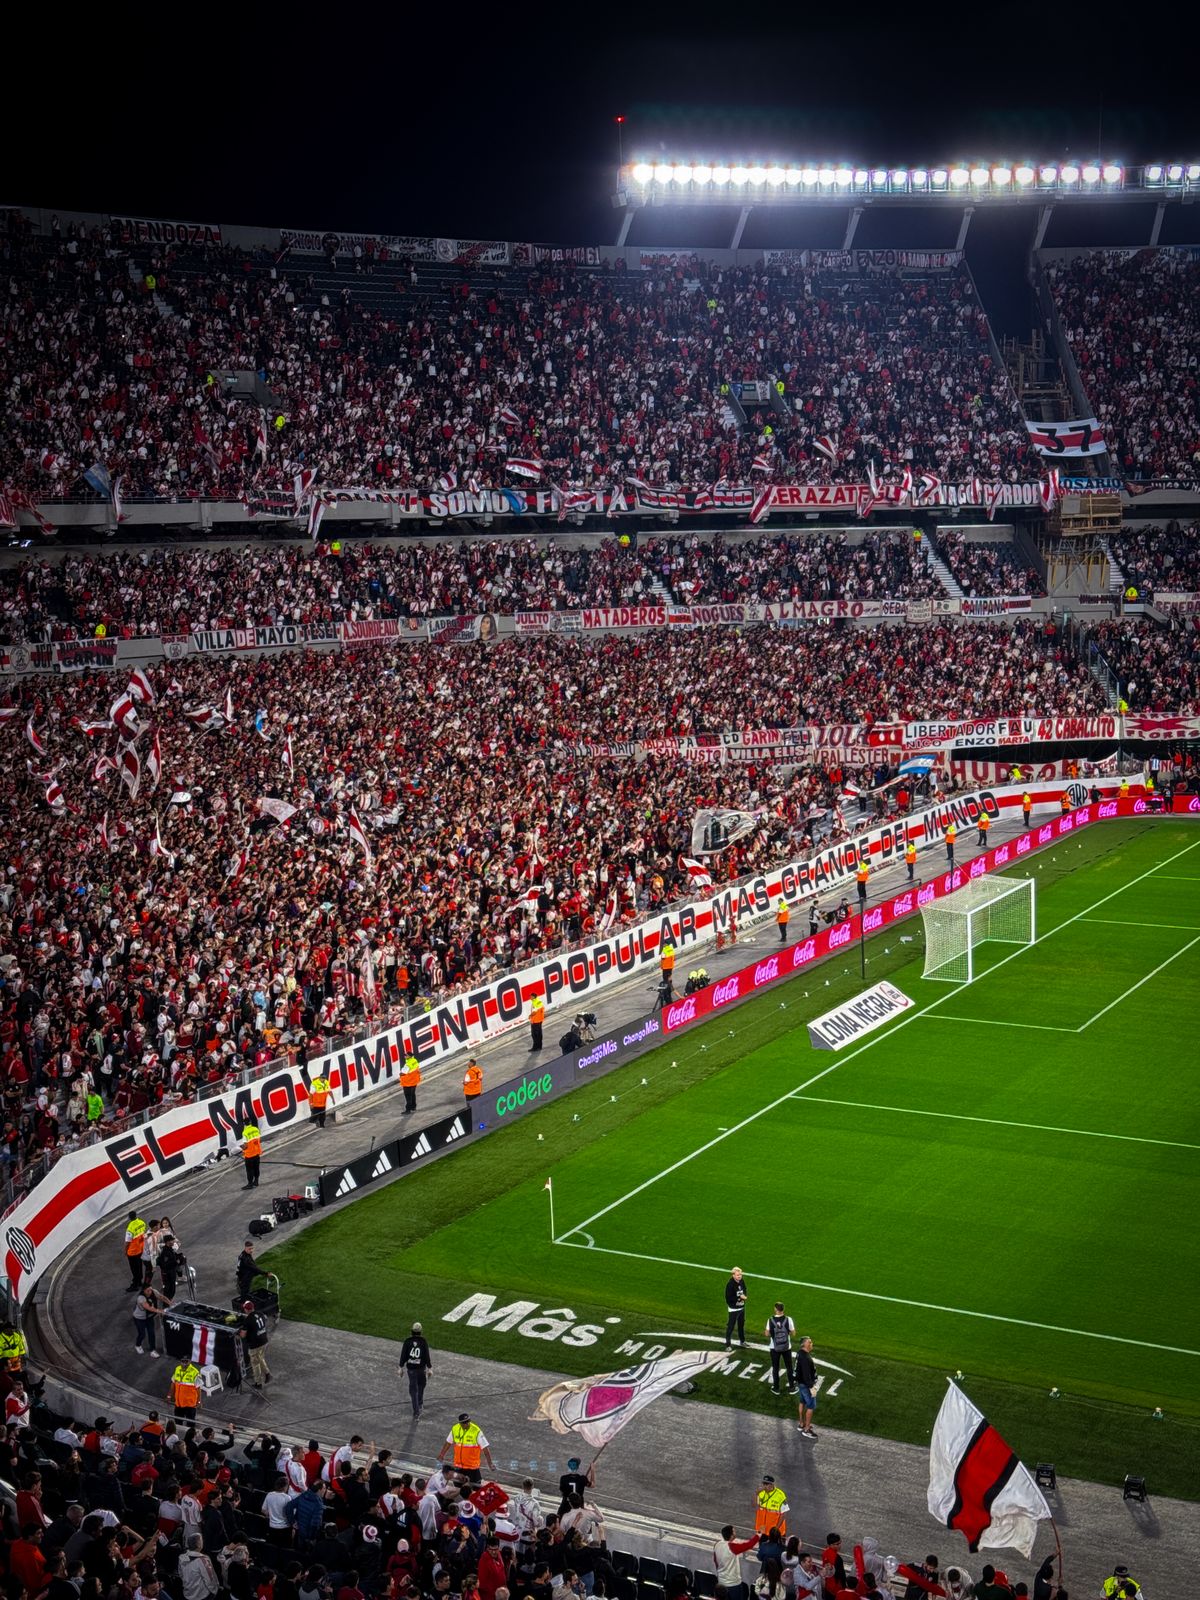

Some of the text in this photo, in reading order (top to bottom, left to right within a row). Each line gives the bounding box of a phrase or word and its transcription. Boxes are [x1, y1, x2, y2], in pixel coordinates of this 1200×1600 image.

[1037, 424, 1092, 453] 37
[1060, 477, 1121, 489] OSARIO
[536, 489, 628, 513] FITA
[984, 483, 1041, 506] CORDO
[515, 613, 549, 625] JULITO
[583, 607, 666, 628] MATADEROS
[691, 605, 745, 623] NOGUES
[763, 601, 864, 622] ALMAGRO
[193, 630, 236, 651] VILLA
[237, 629, 255, 648] DE
[256, 627, 297, 646] MAYO
[742, 730, 779, 746] GARIN
[905, 723, 995, 738] LIBERTADOR
[1037, 717, 1115, 739] 42 CABALLITO
[1126, 730, 1200, 739] FLORES
[729, 747, 772, 760] VILLA
[906, 737, 995, 749] NICO ENZO
[686, 749, 721, 763] JUSTO
[105, 1126, 185, 1192] EL
[208, 977, 523, 1149] MOVIMIENTO
[543, 907, 697, 1004] POPULAR
[712, 878, 770, 933] MAS
[781, 837, 872, 900] GRANDE
[881, 821, 915, 859] DEL
[923, 791, 1000, 842] MUNDO
[813, 992, 898, 1046] LOMA NEGRA
[496, 1073, 552, 1117] codere
[409, 1347, 421, 1358] 40
[614, 1340, 843, 1396] MOMENAL
